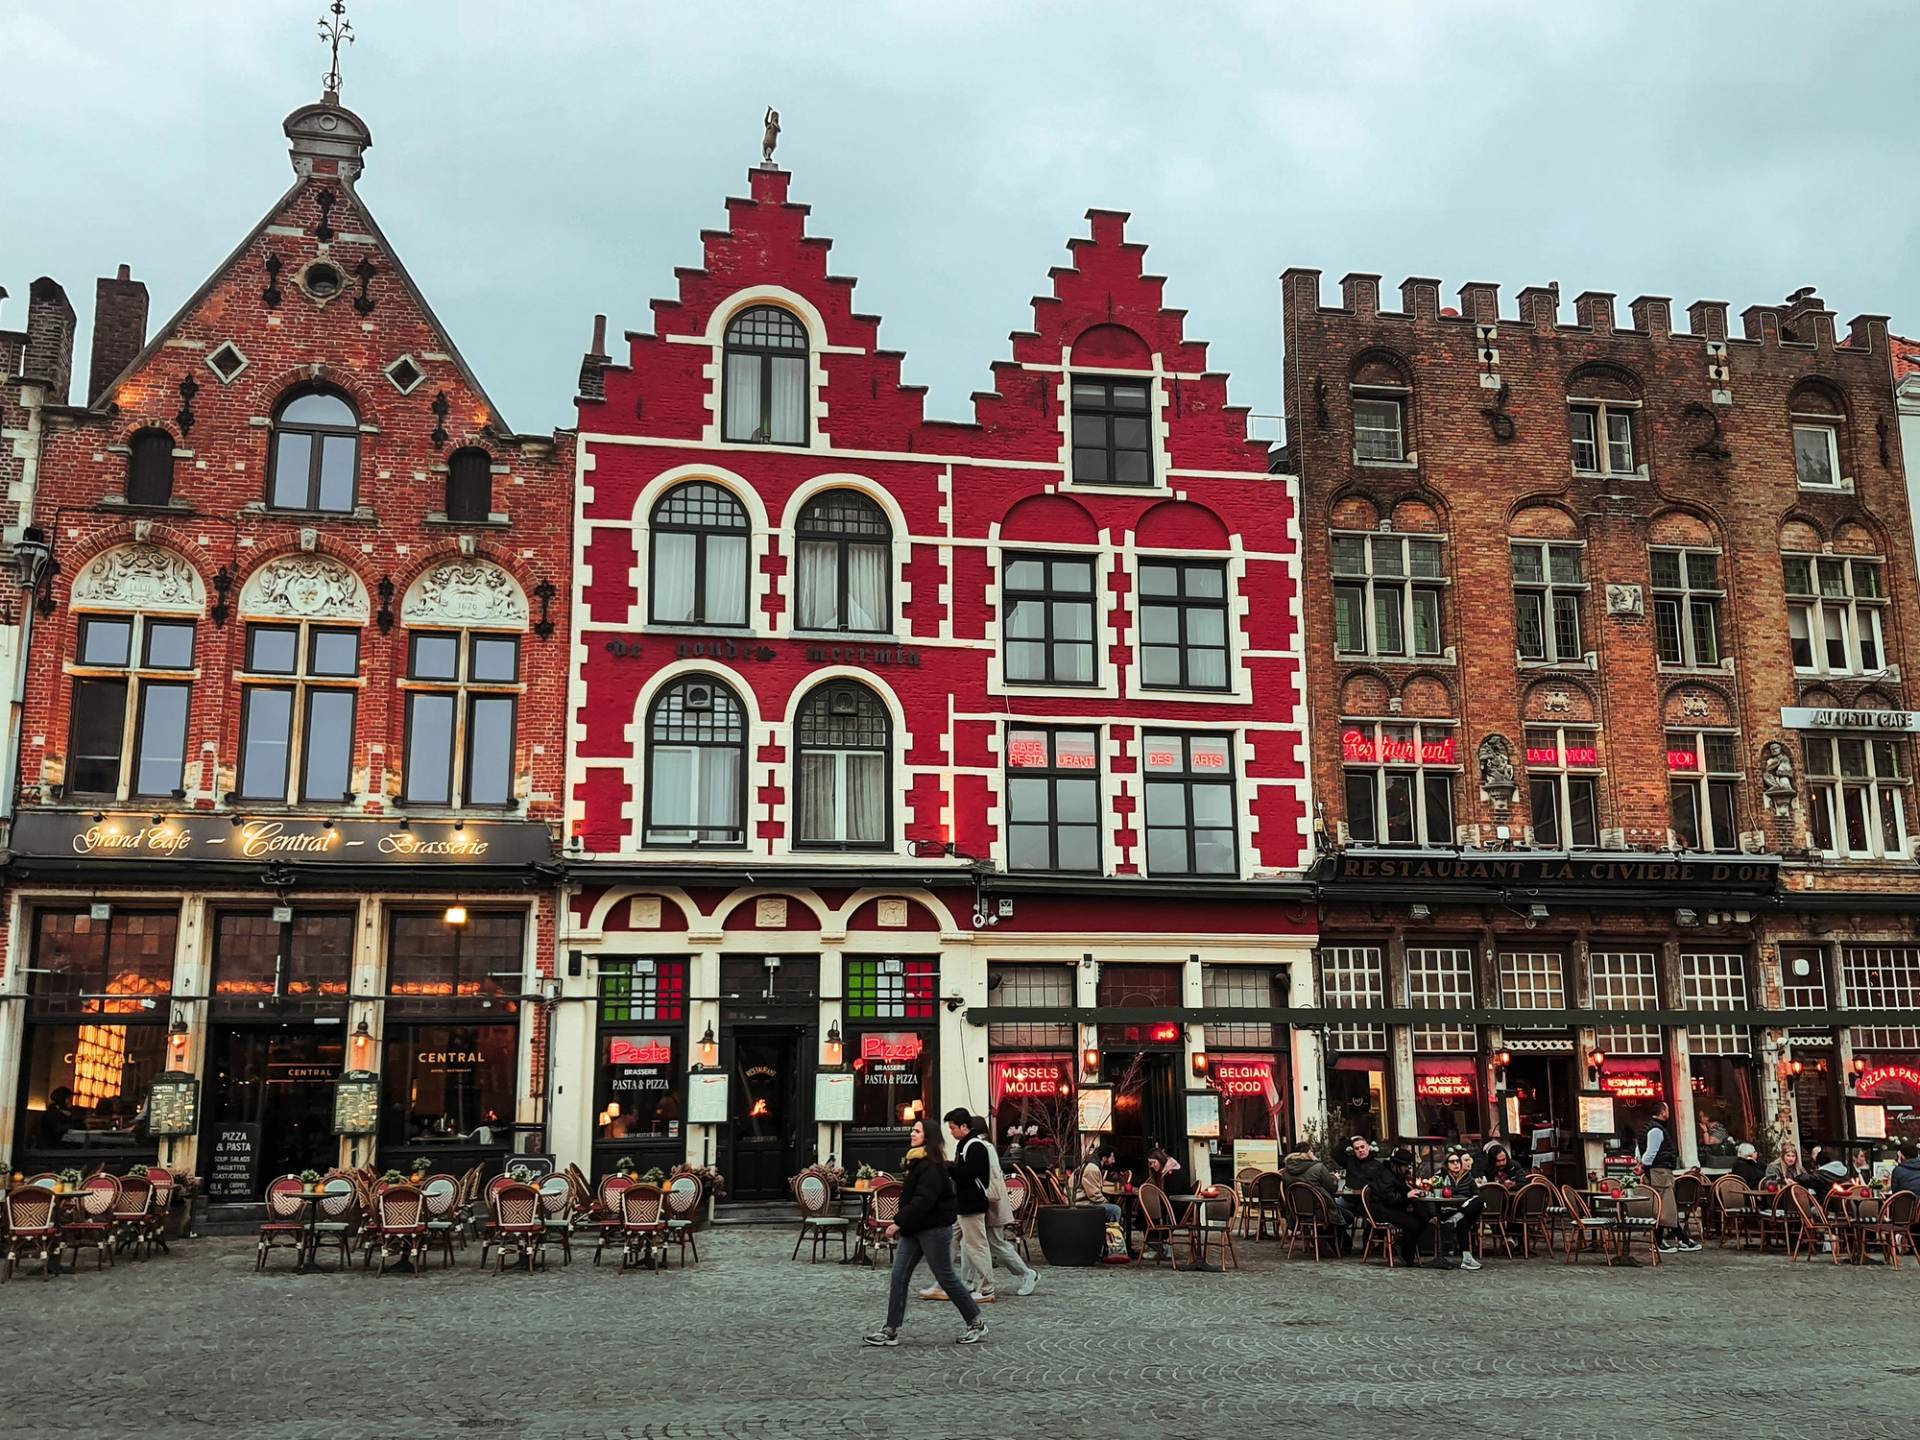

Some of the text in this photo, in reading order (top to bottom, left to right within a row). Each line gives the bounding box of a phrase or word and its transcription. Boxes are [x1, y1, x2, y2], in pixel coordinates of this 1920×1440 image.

[1150, 754, 1173, 765] DES
[1193, 754, 1224, 766] ARTS
[73, 826, 145, 854] Grand
[241, 820, 336, 858] Central
[377, 833, 489, 855] Brasserie
[1343, 860, 1770, 882] RESTAURANT LA CIVIERE D'OR
[611, 1040, 671, 1062] Pasta
[864, 1037, 915, 1058] Pizza
[418, 1052, 486, 1063] CENTRAL
[287, 1068, 332, 1077] CENTRAL
[623, 1068, 658, 1076] BRASSERIE
[874, 1064, 906, 1072] BRASSERIE
[1001, 1067, 1059, 1079] MUSSELS
[1220, 1067, 1269, 1078] BELGIAN
[612, 1079, 637, 1090] PASTA
[646, 1079, 670, 1090] PIZZA
[864, 1074, 888, 1085] PASTA
[896, 1074, 919, 1085] PIZZA
[1425, 1076, 1462, 1085] BRASSERIE
[1860, 1069, 1888, 1091] PIZZA
[1005, 1081, 1056, 1094] MOULES
[1228, 1081, 1261, 1092] FOOD
[222, 1132, 247, 1140] PIZZA
[215, 1142, 251, 1152] & PASTA
